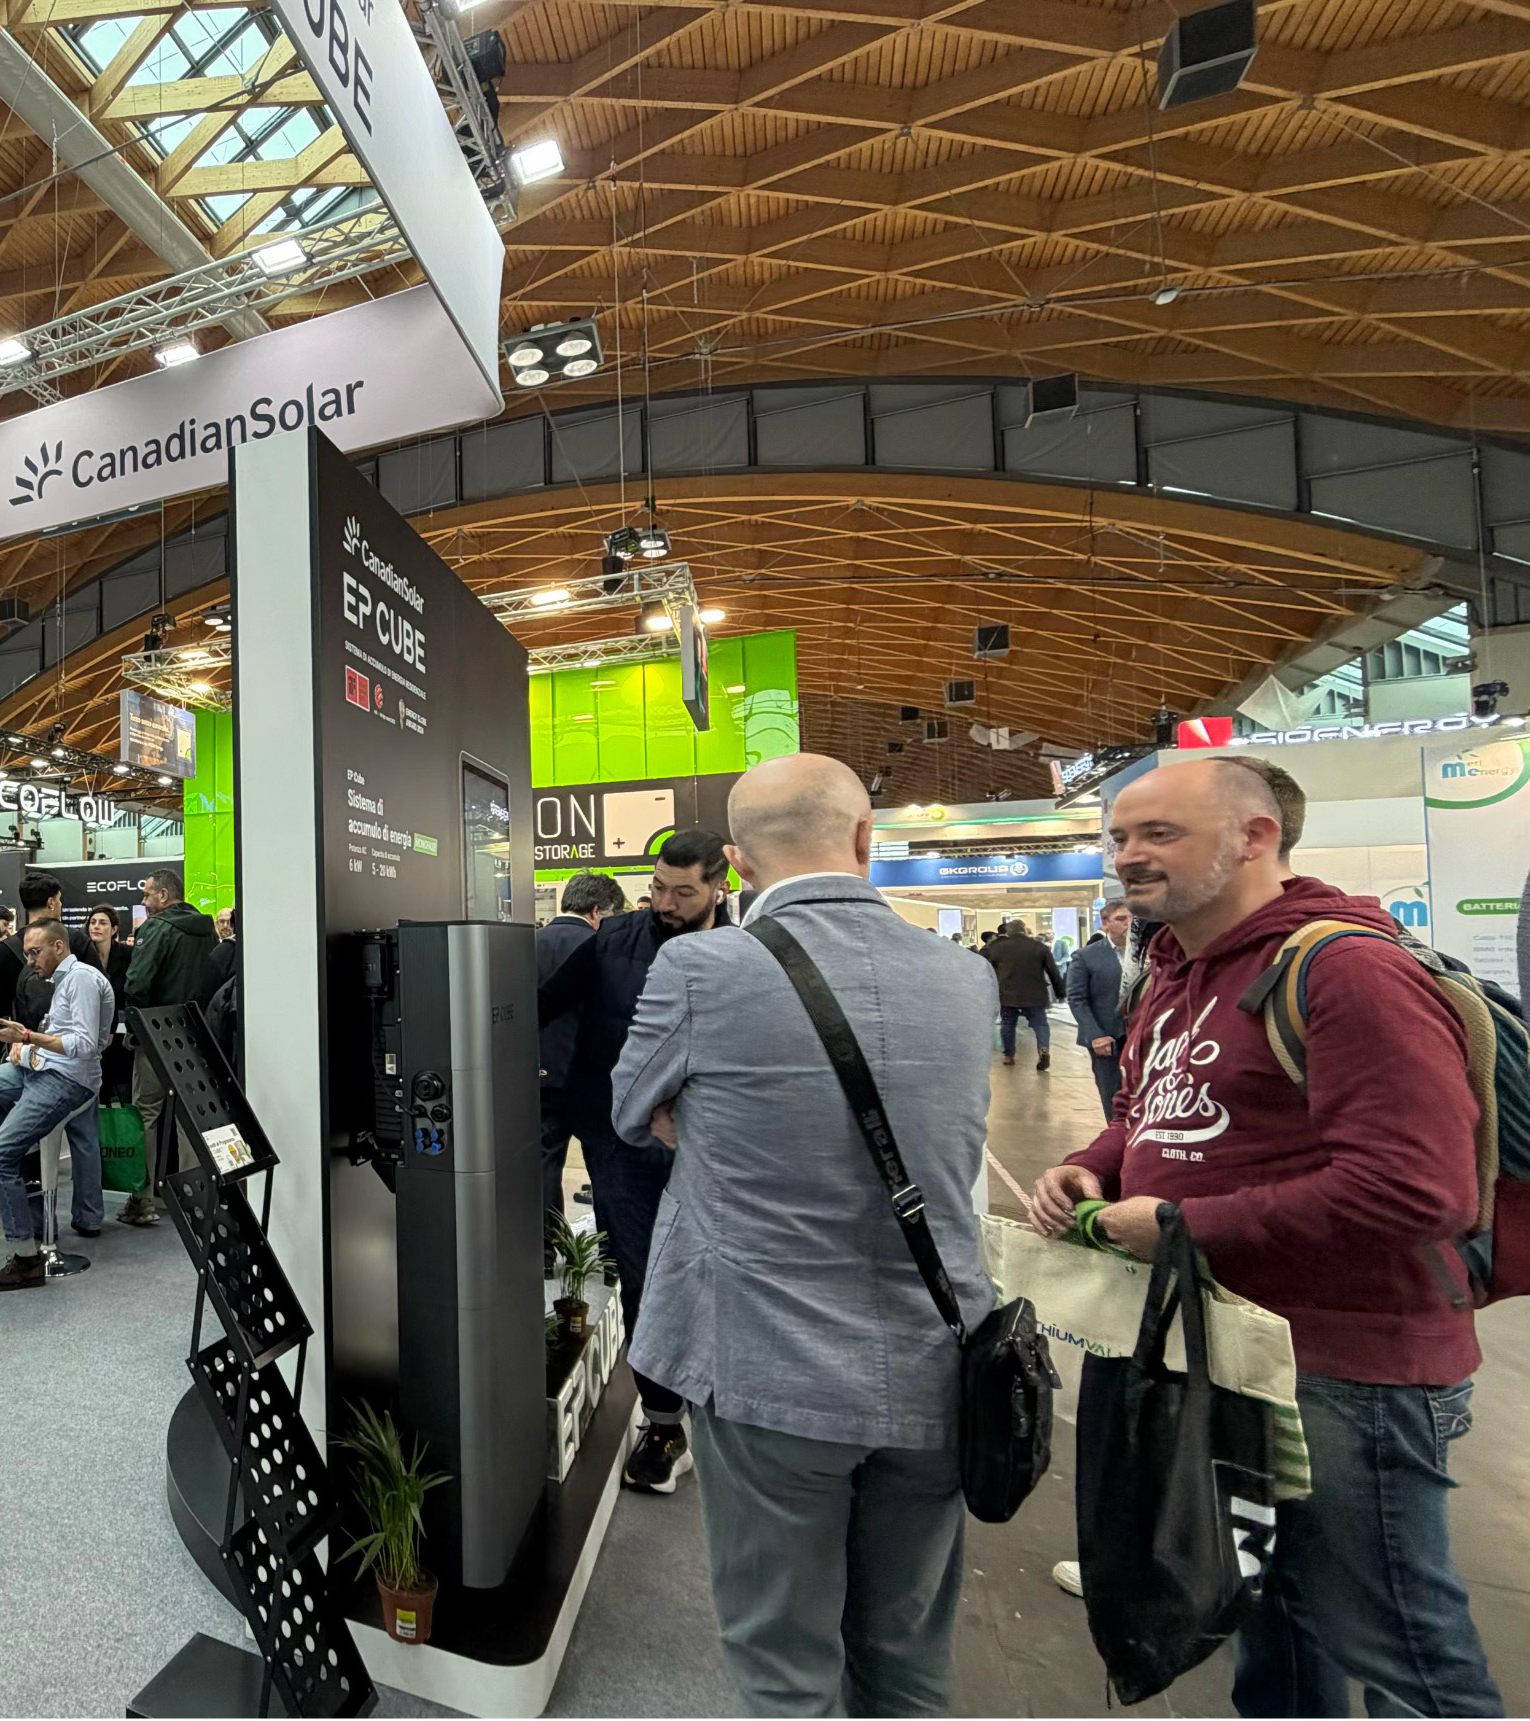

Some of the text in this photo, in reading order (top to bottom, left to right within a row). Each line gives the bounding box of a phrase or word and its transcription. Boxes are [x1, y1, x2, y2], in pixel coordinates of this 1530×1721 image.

[70, 379, 365, 489] CanadianSolar
[361, 538, 425, 615] CanadianSolar
[342, 571, 427, 675] EP CUBE
[347, 769, 365, 785] EP Cube
[347, 789, 384, 816] Sistema di
[348, 819, 412, 850] accumulo di energia
[534, 842, 596, 861] STORAGE
[349, 859, 363, 873] 6 kW
[371, 863, 397, 879] 5 20 kWh
[1161, 1147, 1206, 1163] CLOTH. CO.
